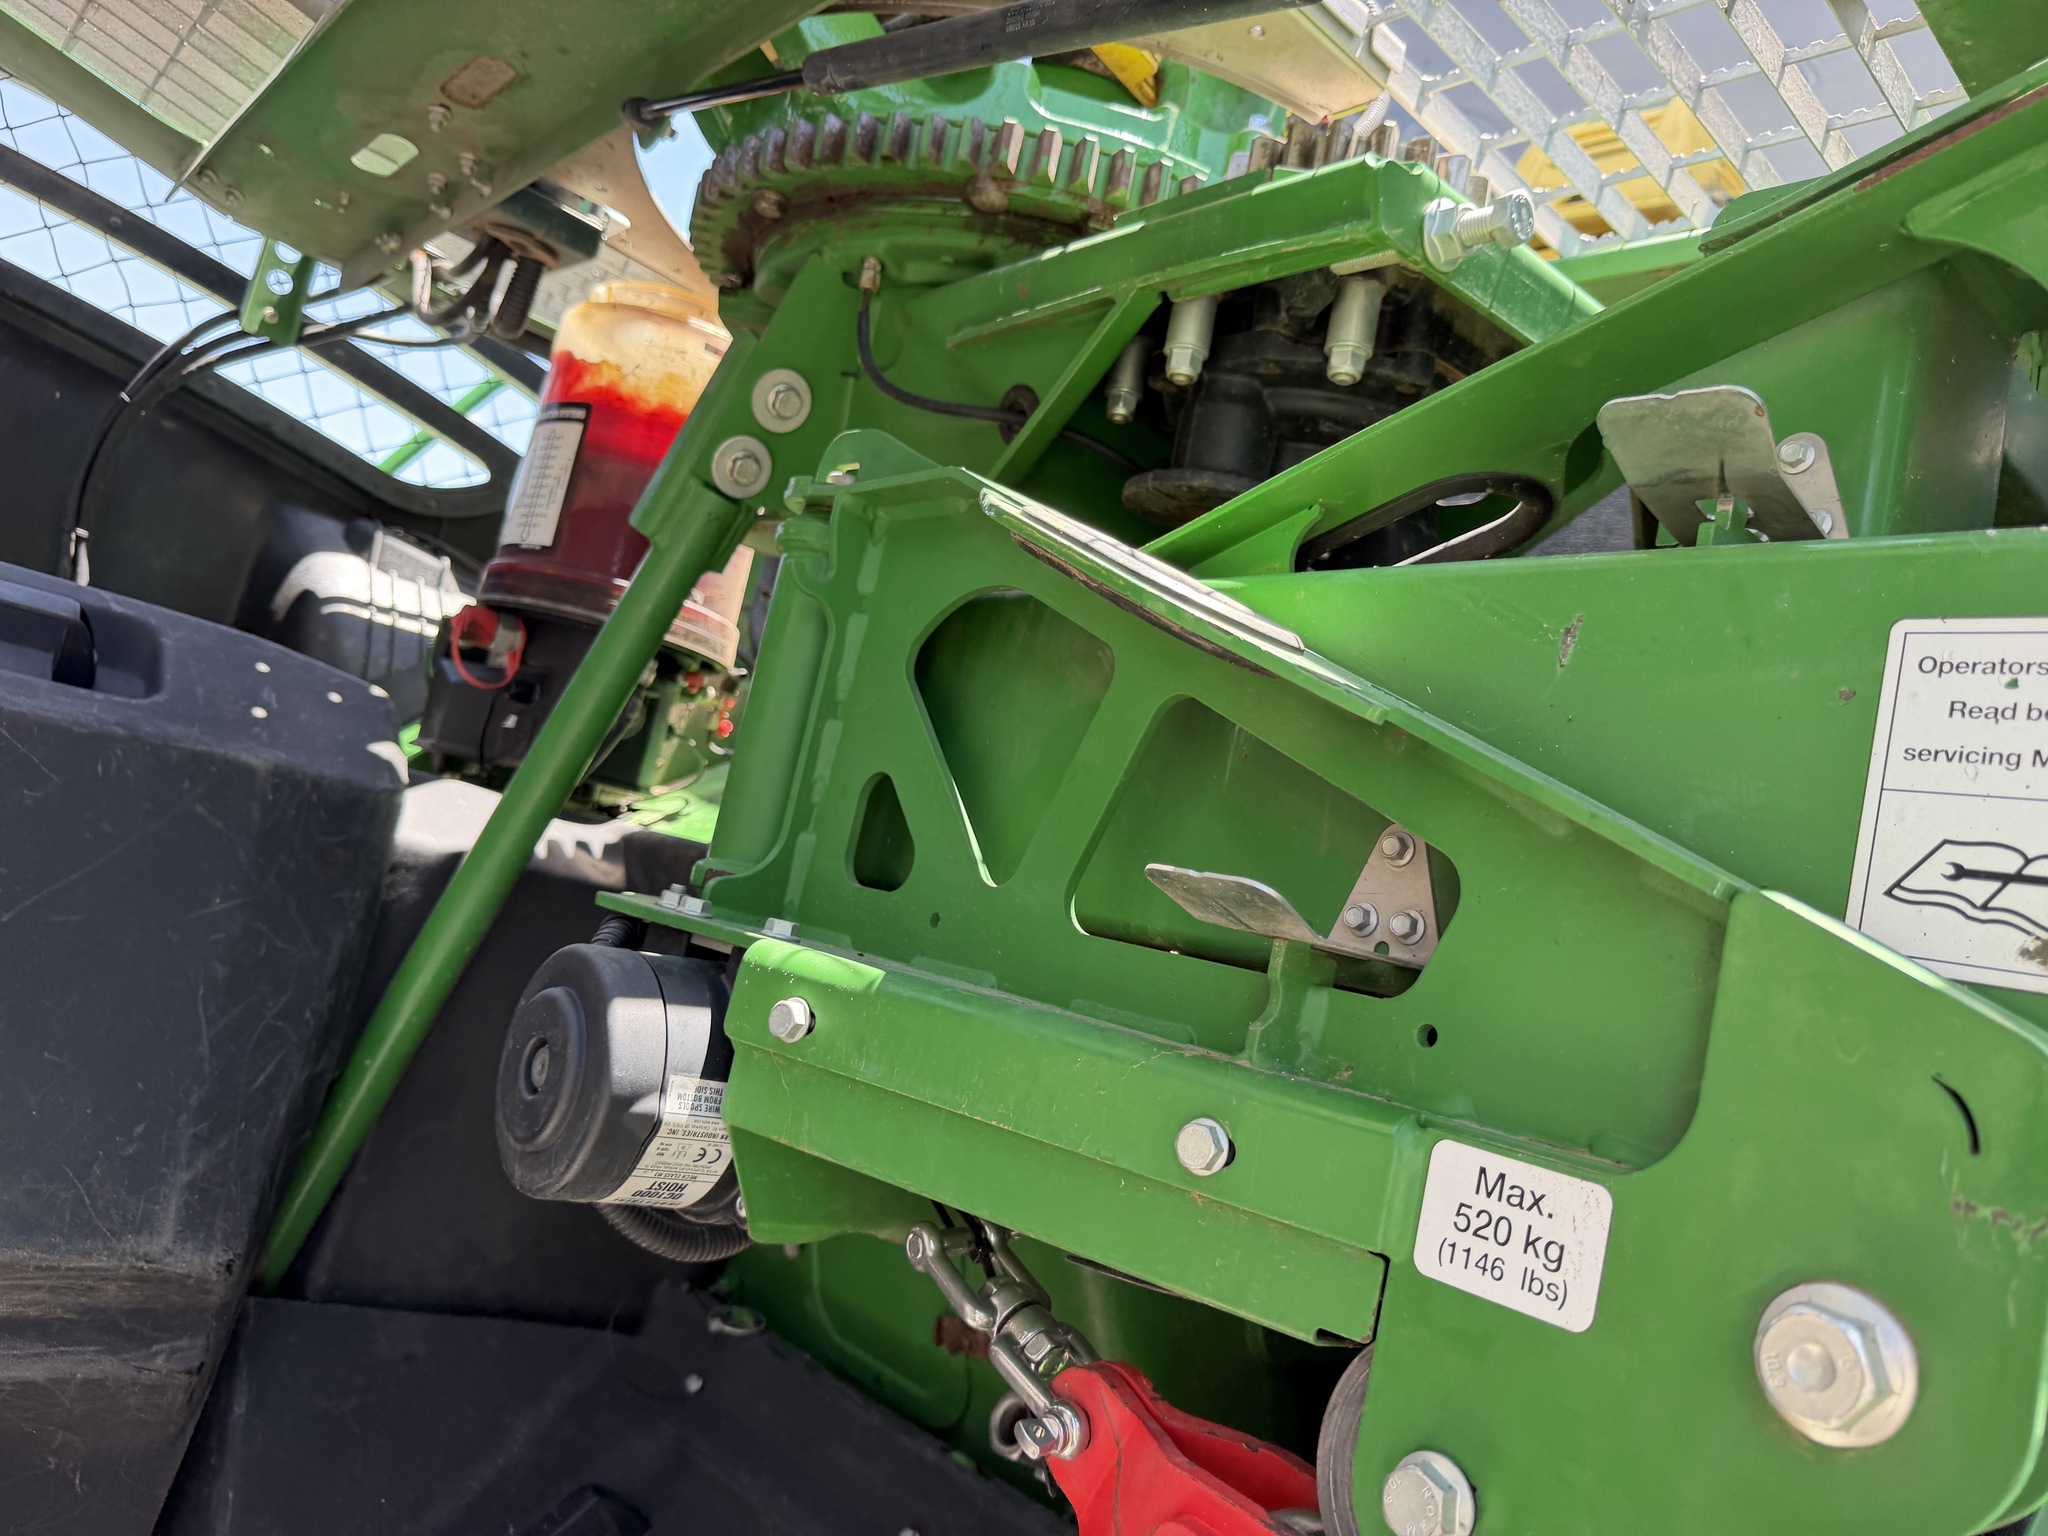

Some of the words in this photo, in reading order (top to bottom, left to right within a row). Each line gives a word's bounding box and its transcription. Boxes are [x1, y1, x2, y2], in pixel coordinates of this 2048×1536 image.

[1917, 655, 2048, 678] Operators
[1948, 700, 2018, 721] Read
[2026, 702, 2048, 721] b
[1903, 746, 2021, 771] servicing
[709, 1087, 724, 1096] THIS
[677, 1093, 702, 1102] BOTTOM
[704, 1095, 722, 1105] FROM
[678, 1101, 703, 1112] SPOOLS
[705, 1104, 721, 1114] WIRE
[681, 1129, 719, 1140] INDUSTRIES,
[646, 1180, 688, 1191] HOIST
[631, 1190, 684, 1199] DC1000
[1474, 1165, 1554, 1219] Max.
[1453, 1202, 1512, 1247] 520
[1522, 1224, 1565, 1273] kg
[1438, 1237, 1505, 1281] (1146
[1520, 1267, 1568, 1311] lbs)
